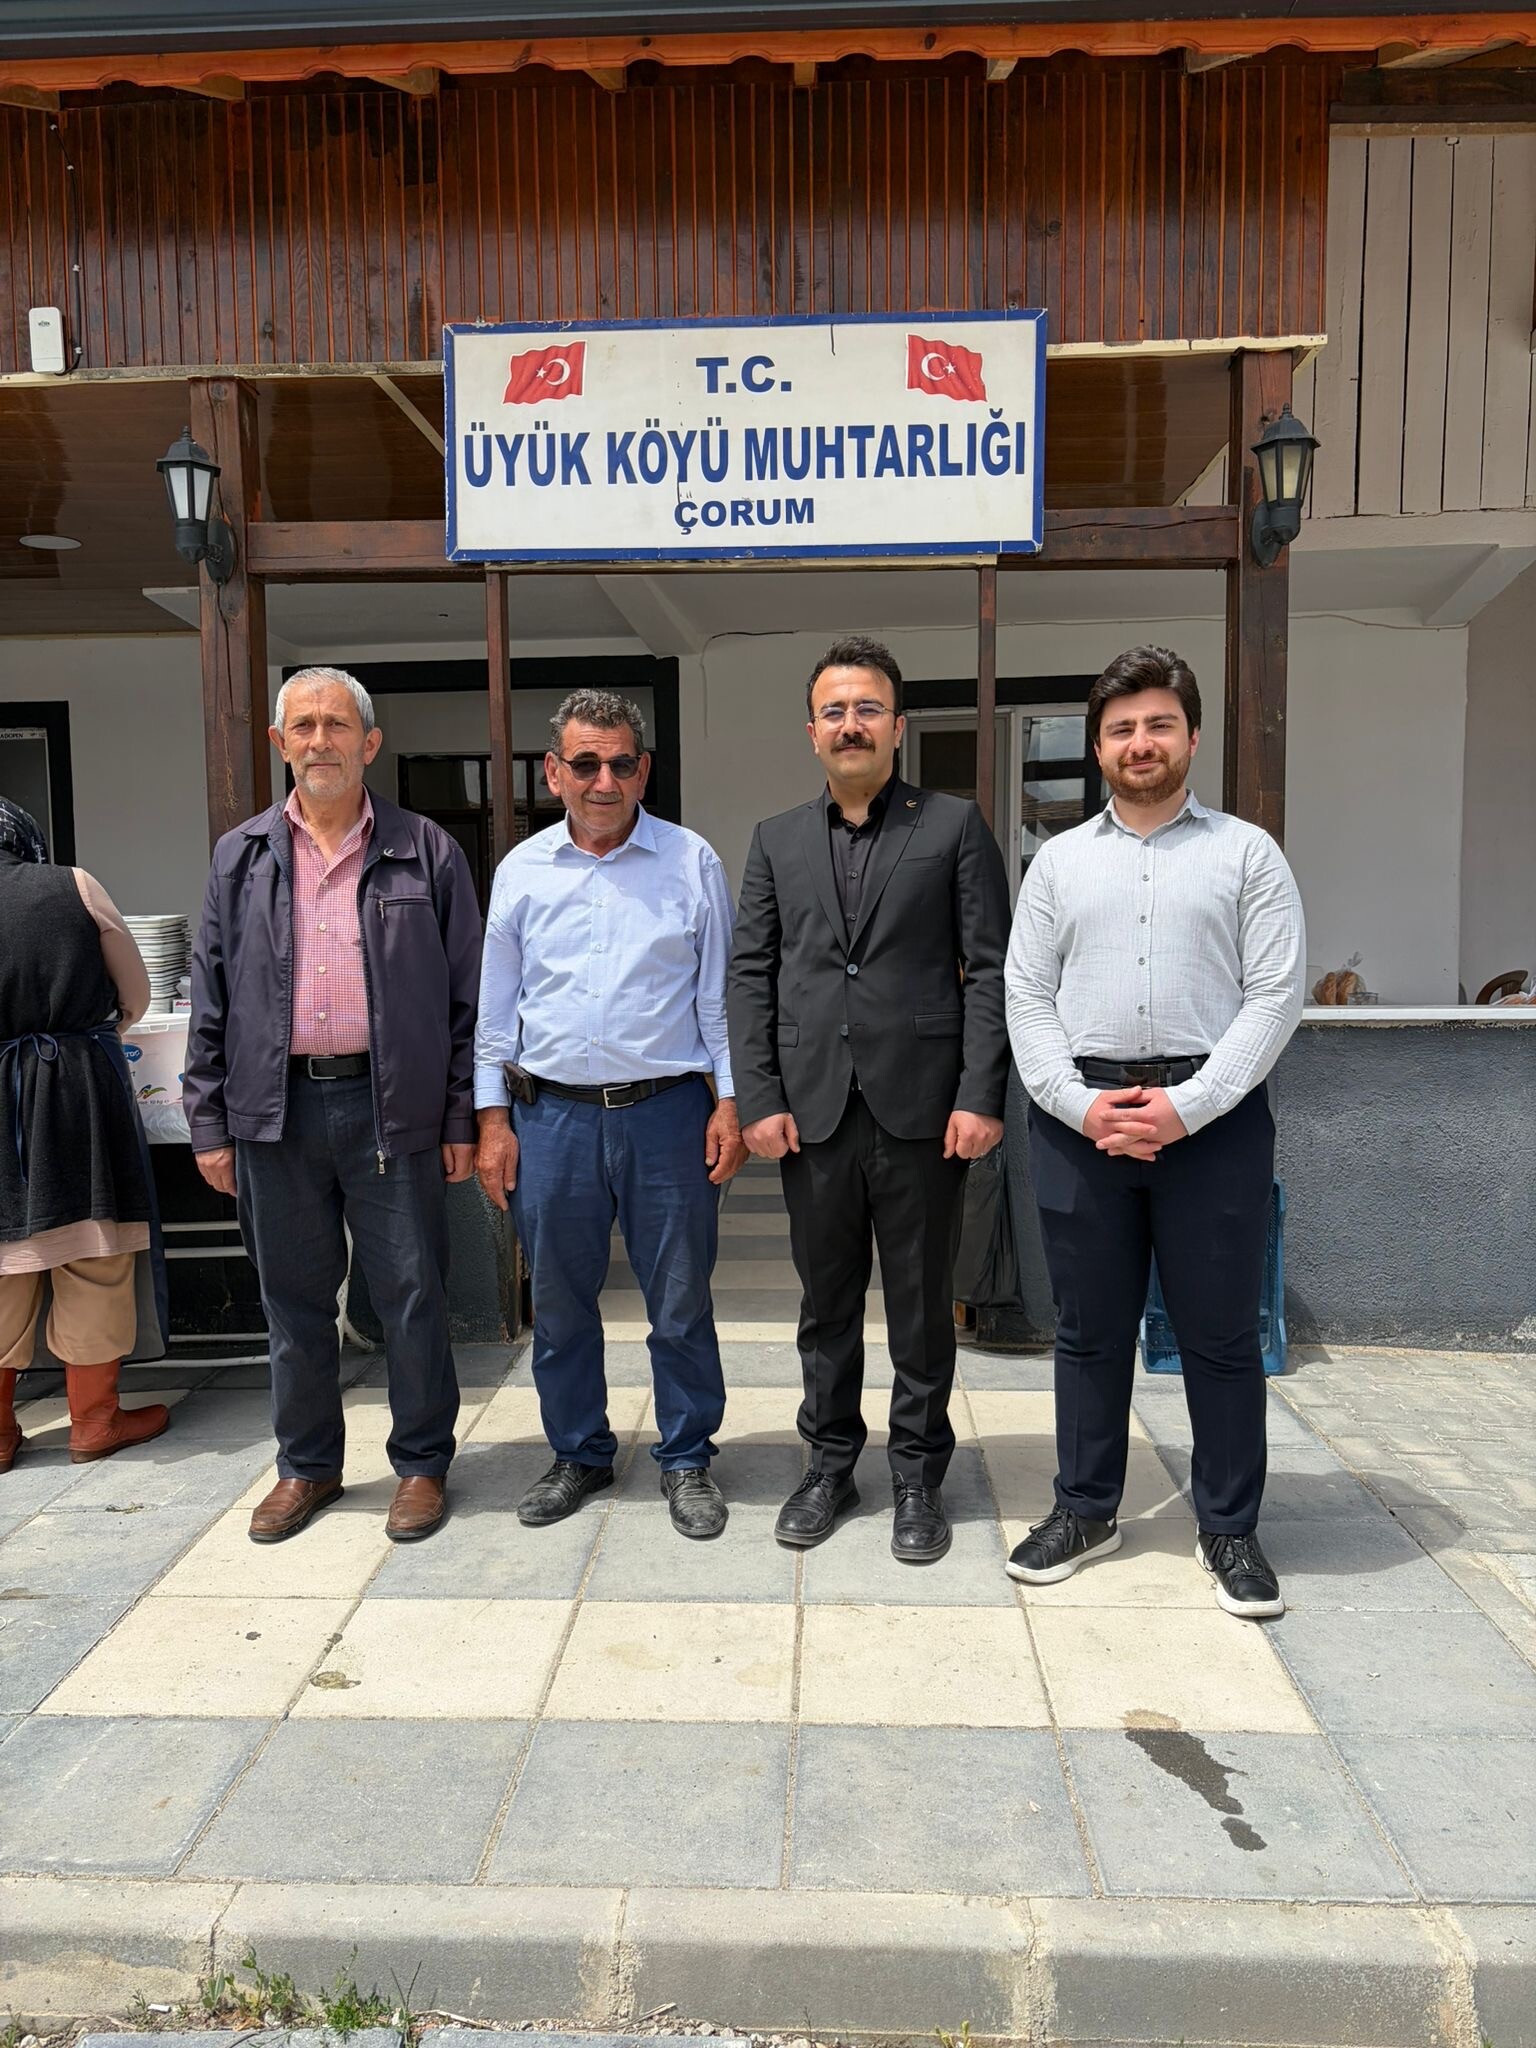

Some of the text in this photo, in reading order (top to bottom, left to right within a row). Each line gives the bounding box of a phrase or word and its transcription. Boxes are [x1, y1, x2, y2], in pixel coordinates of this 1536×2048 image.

[696, 356, 792, 394] T.C.
[464, 408, 1025, 488] ÜYÜK KÖYÜ MUHTARLIĞI
[675, 498, 815, 535] ÇORUM
